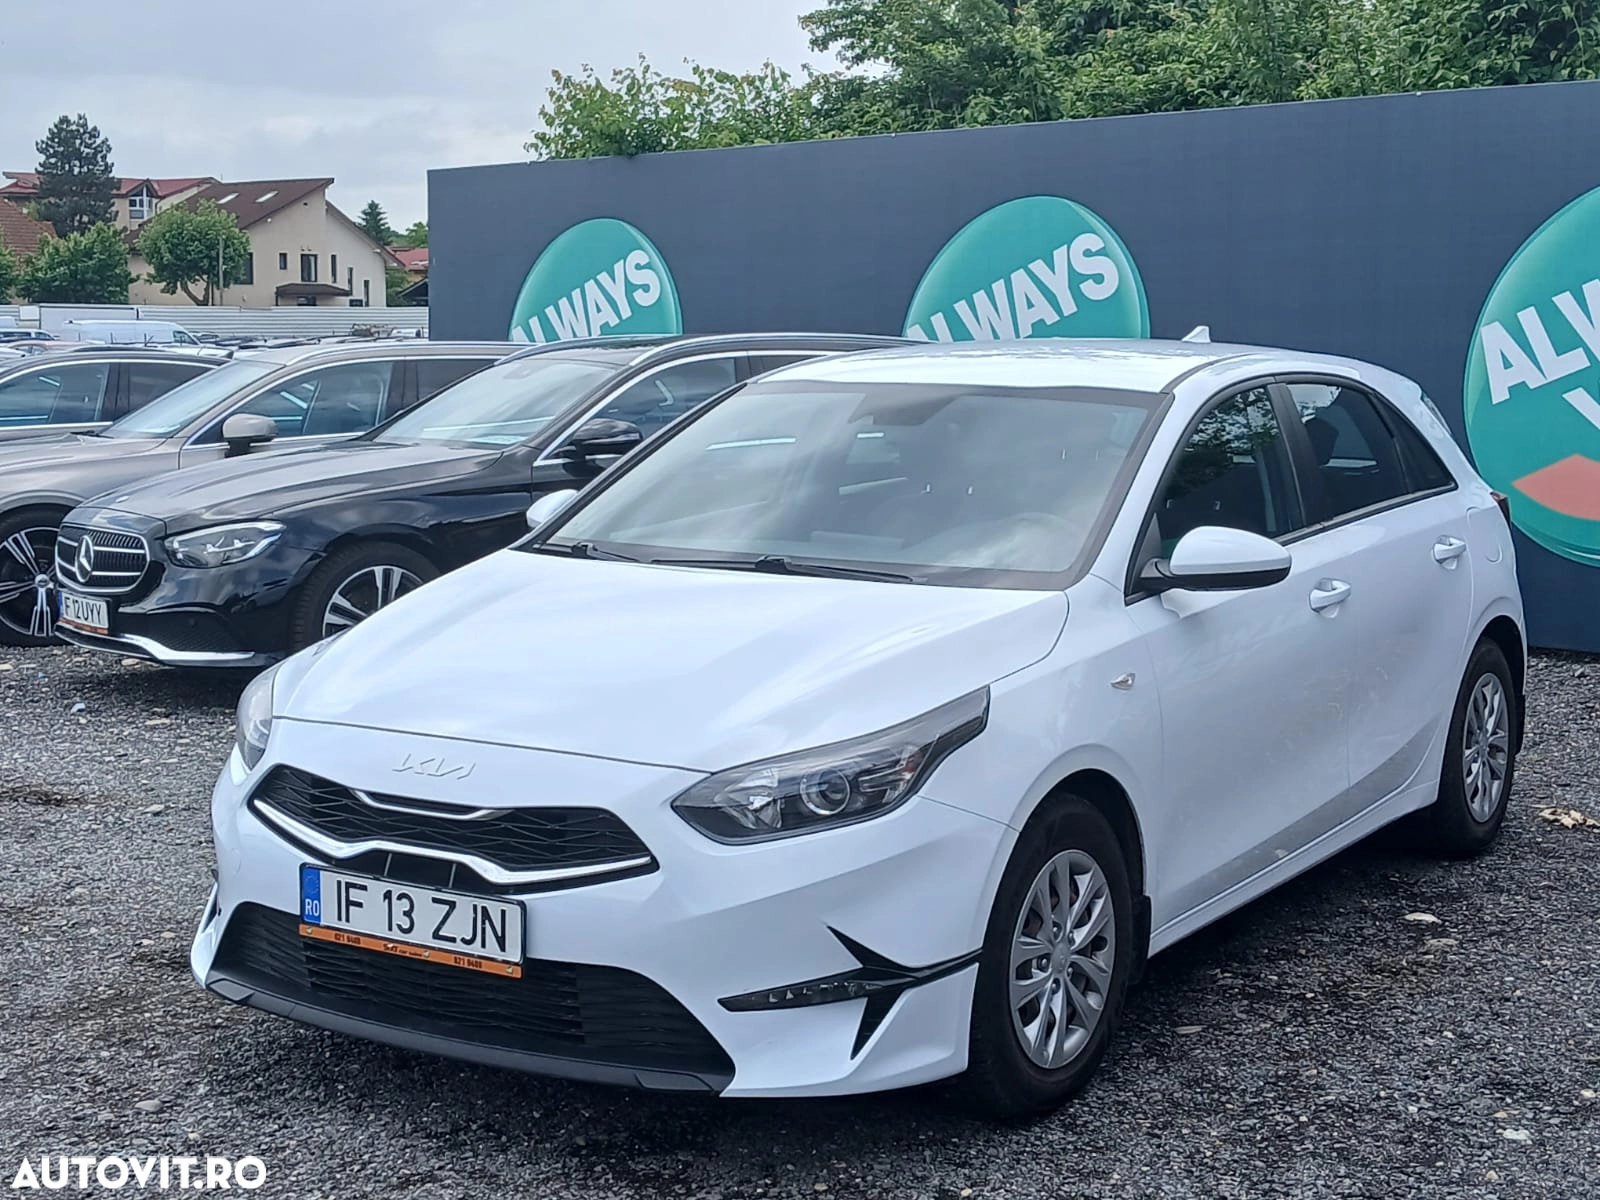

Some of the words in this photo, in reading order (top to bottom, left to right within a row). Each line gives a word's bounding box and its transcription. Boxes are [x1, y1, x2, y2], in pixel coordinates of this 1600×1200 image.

[305, 899, 320, 917] RO
[336, 879, 368, 923] IF
[382, 889, 416, 934] 13
[431, 896, 507, 952] ZJN
